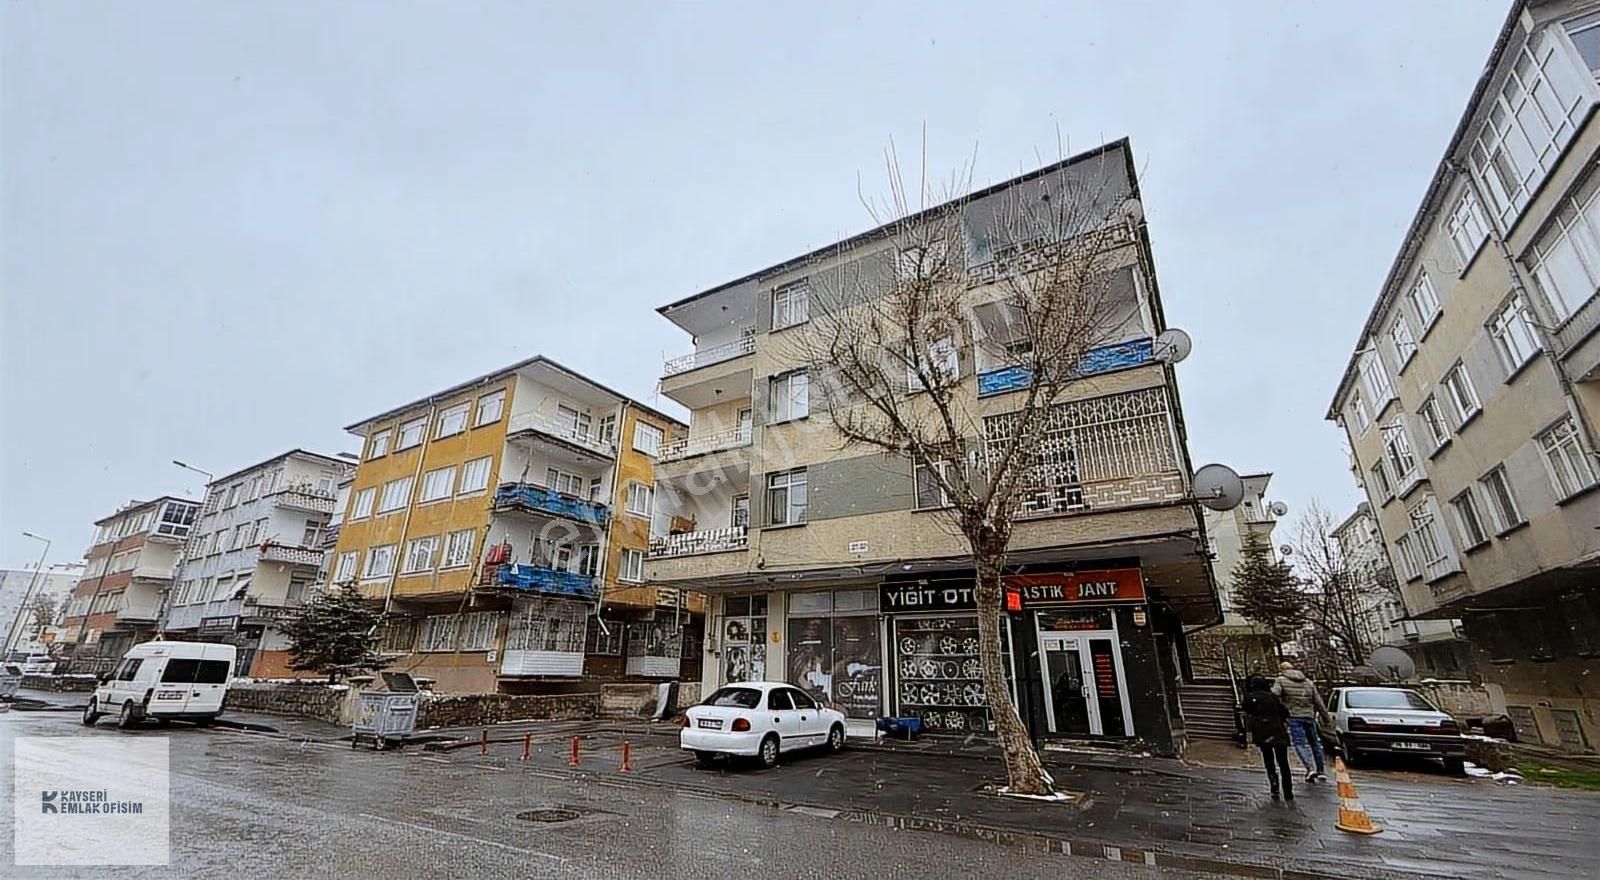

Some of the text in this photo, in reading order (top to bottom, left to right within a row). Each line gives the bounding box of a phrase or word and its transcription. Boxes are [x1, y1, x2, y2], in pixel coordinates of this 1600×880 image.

[887, 585, 936, 606] YİĞİT
[943, 587, 978, 604] OT
[1078, 581, 1117, 597] JANT
